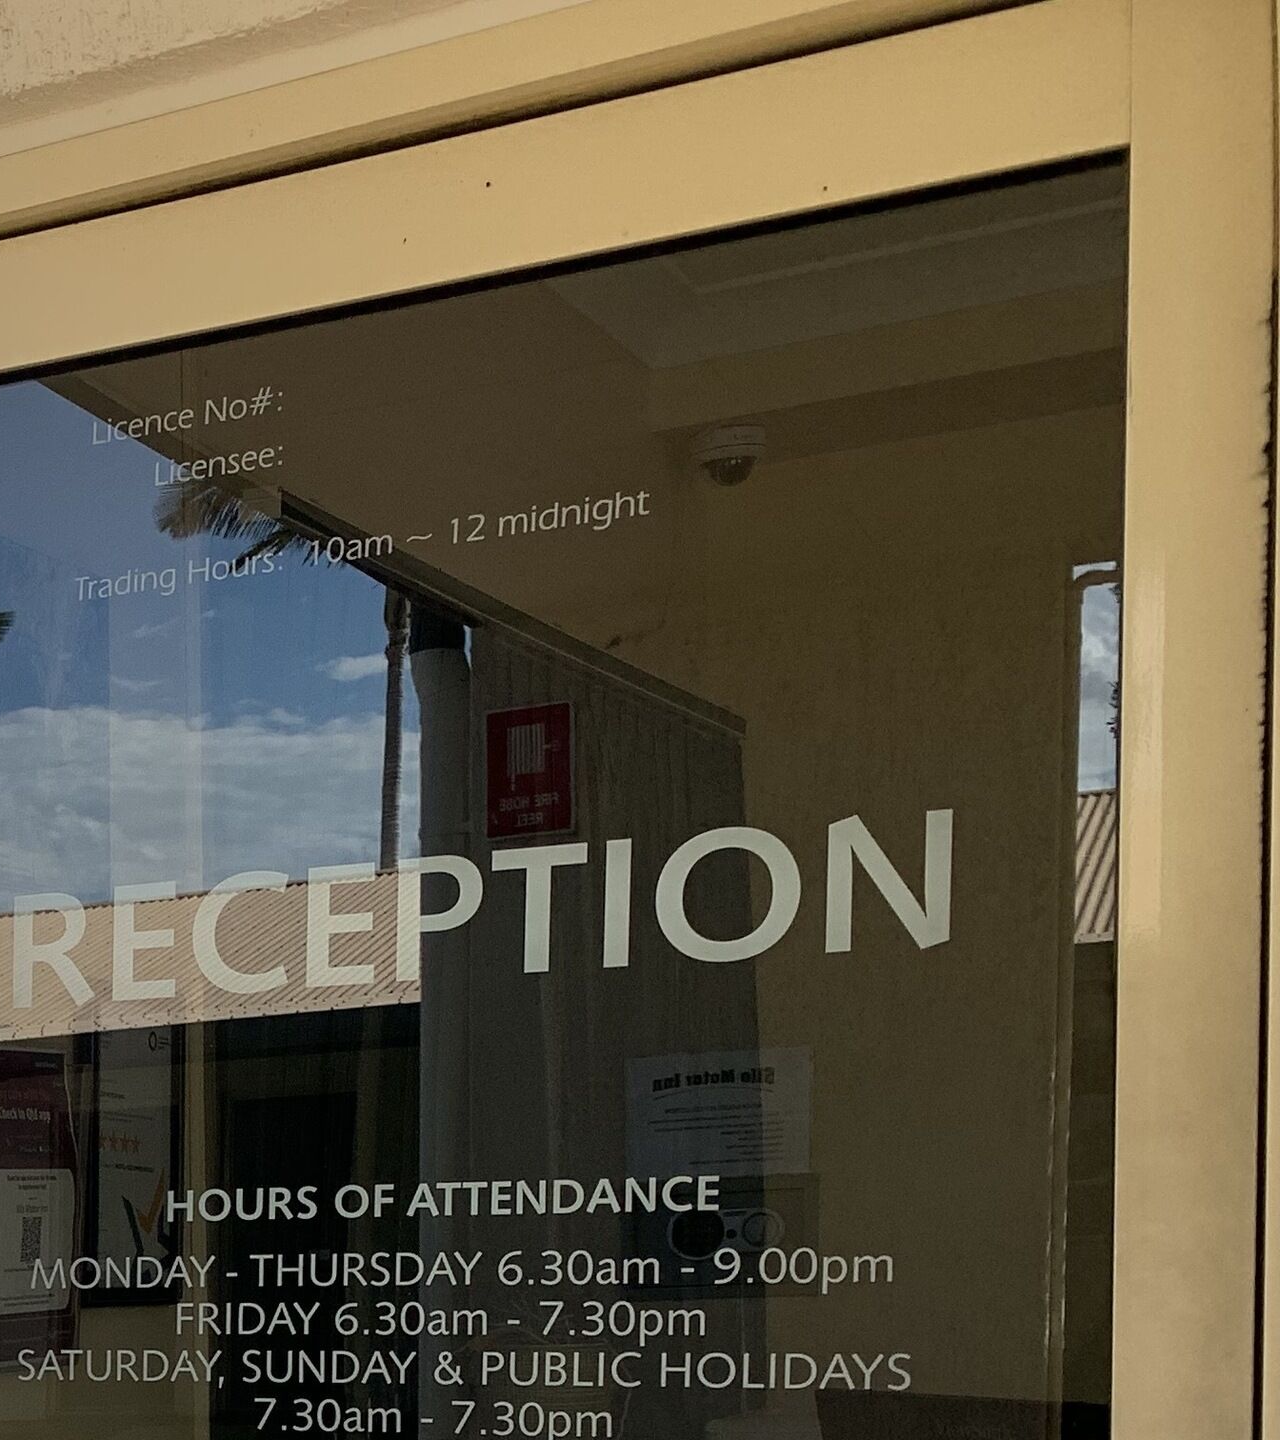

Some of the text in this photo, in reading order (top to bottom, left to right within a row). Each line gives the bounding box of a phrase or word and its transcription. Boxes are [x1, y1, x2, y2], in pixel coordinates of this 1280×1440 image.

[91, 385, 285, 446] Licence No#:
[153, 443, 285, 488] Licensee:
[74, 564, 177, 605] Trading
[187, 549, 285, 586] Hours:
[308, 531, 394, 568] 10am
[448, 513, 486, 546] 12
[498, 488, 652, 539] midnight
[11, 808, 955, 1011] RECEPTION
[166, 1174, 721, 1225] HOURS OF ATTENDANCE
[30, 1256, 217, 1293] MONDAY
[248, 1251, 484, 1291] THURSDAY
[496, 1249, 663, 1288] 6.30am
[712, 1247, 896, 1295] 9.00pm
[174, 1302, 321, 1338] FRIDAY
[333, 1301, 490, 1338] 6.30am
[538, 1301, 708, 1347] 7.30pm
[16, 1348, 914, 1394] SATURDAY, SUNDAY & PUBLIC HOLIDAYS
[252, 1398, 403, 1434] 7.30am
